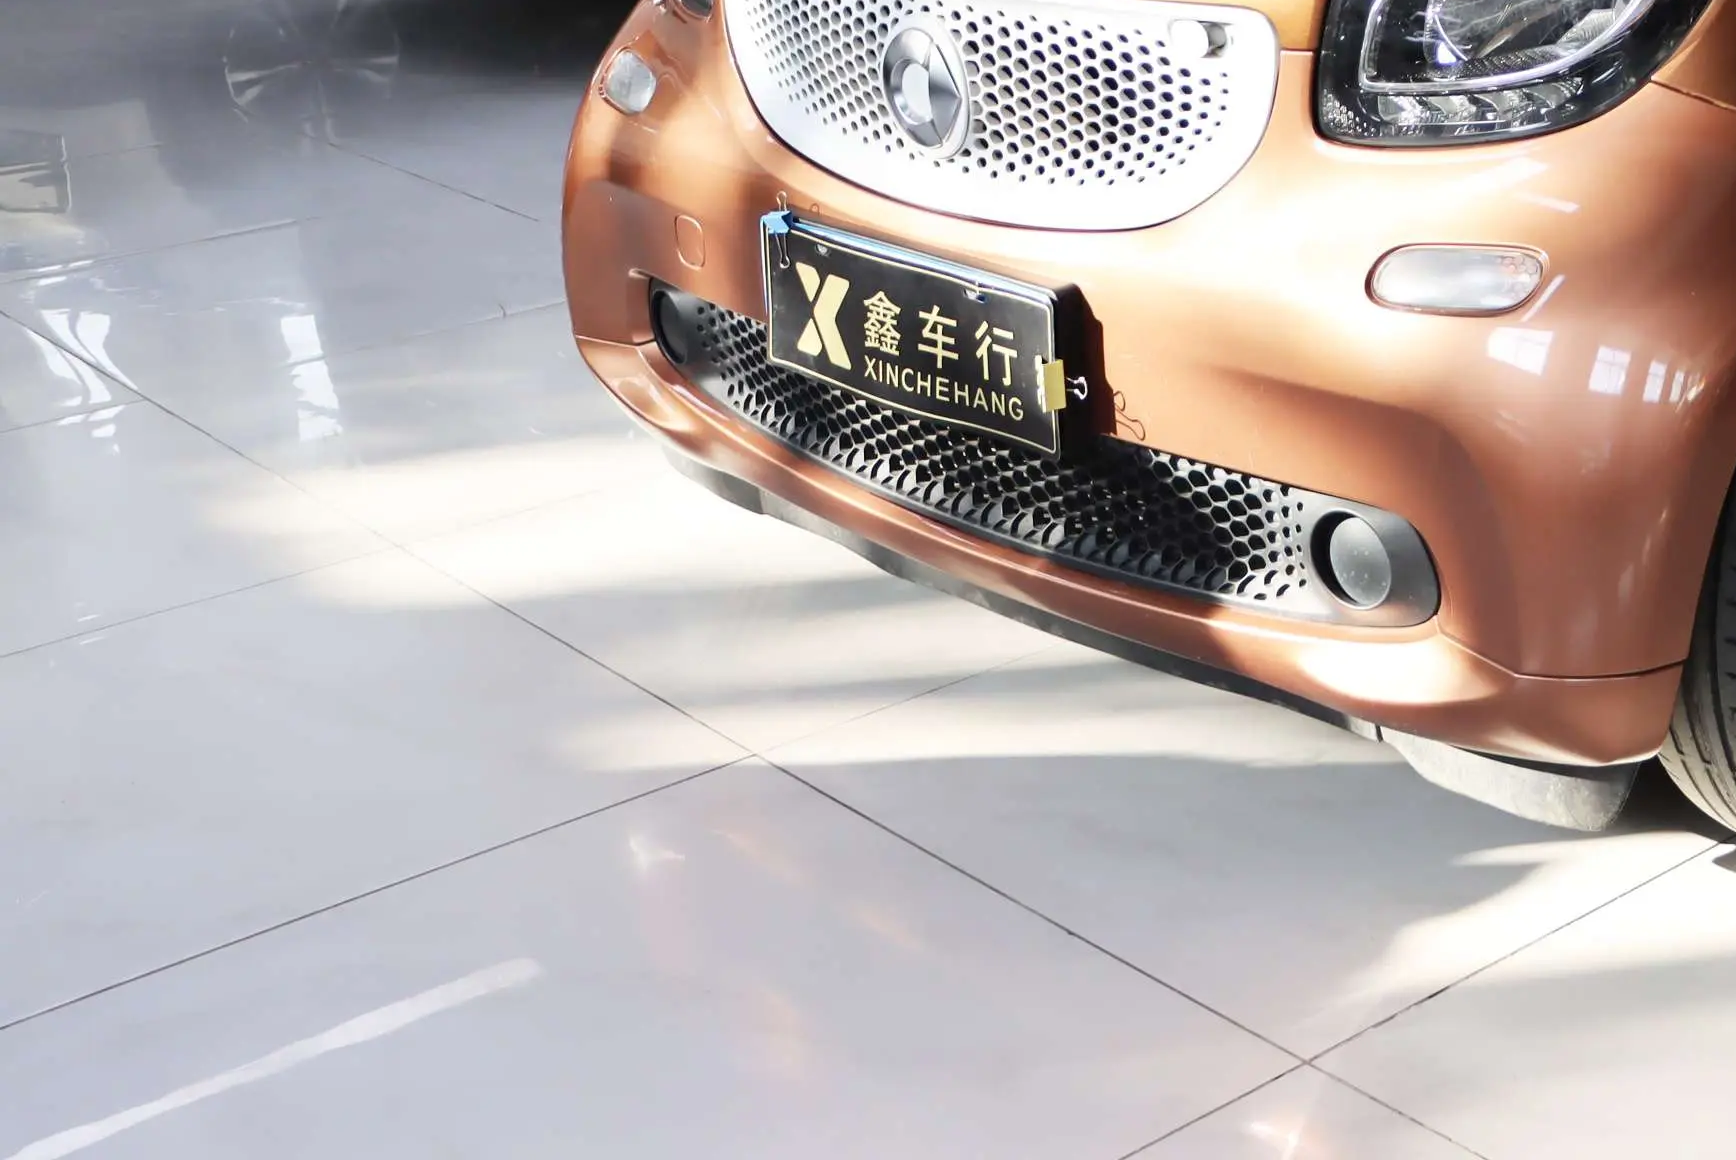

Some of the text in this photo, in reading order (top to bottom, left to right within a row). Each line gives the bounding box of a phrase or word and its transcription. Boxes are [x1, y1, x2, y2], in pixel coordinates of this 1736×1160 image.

[862, 290, 1018, 387] 鑫车行
[863, 354, 1024, 422] XINCHEHANG
